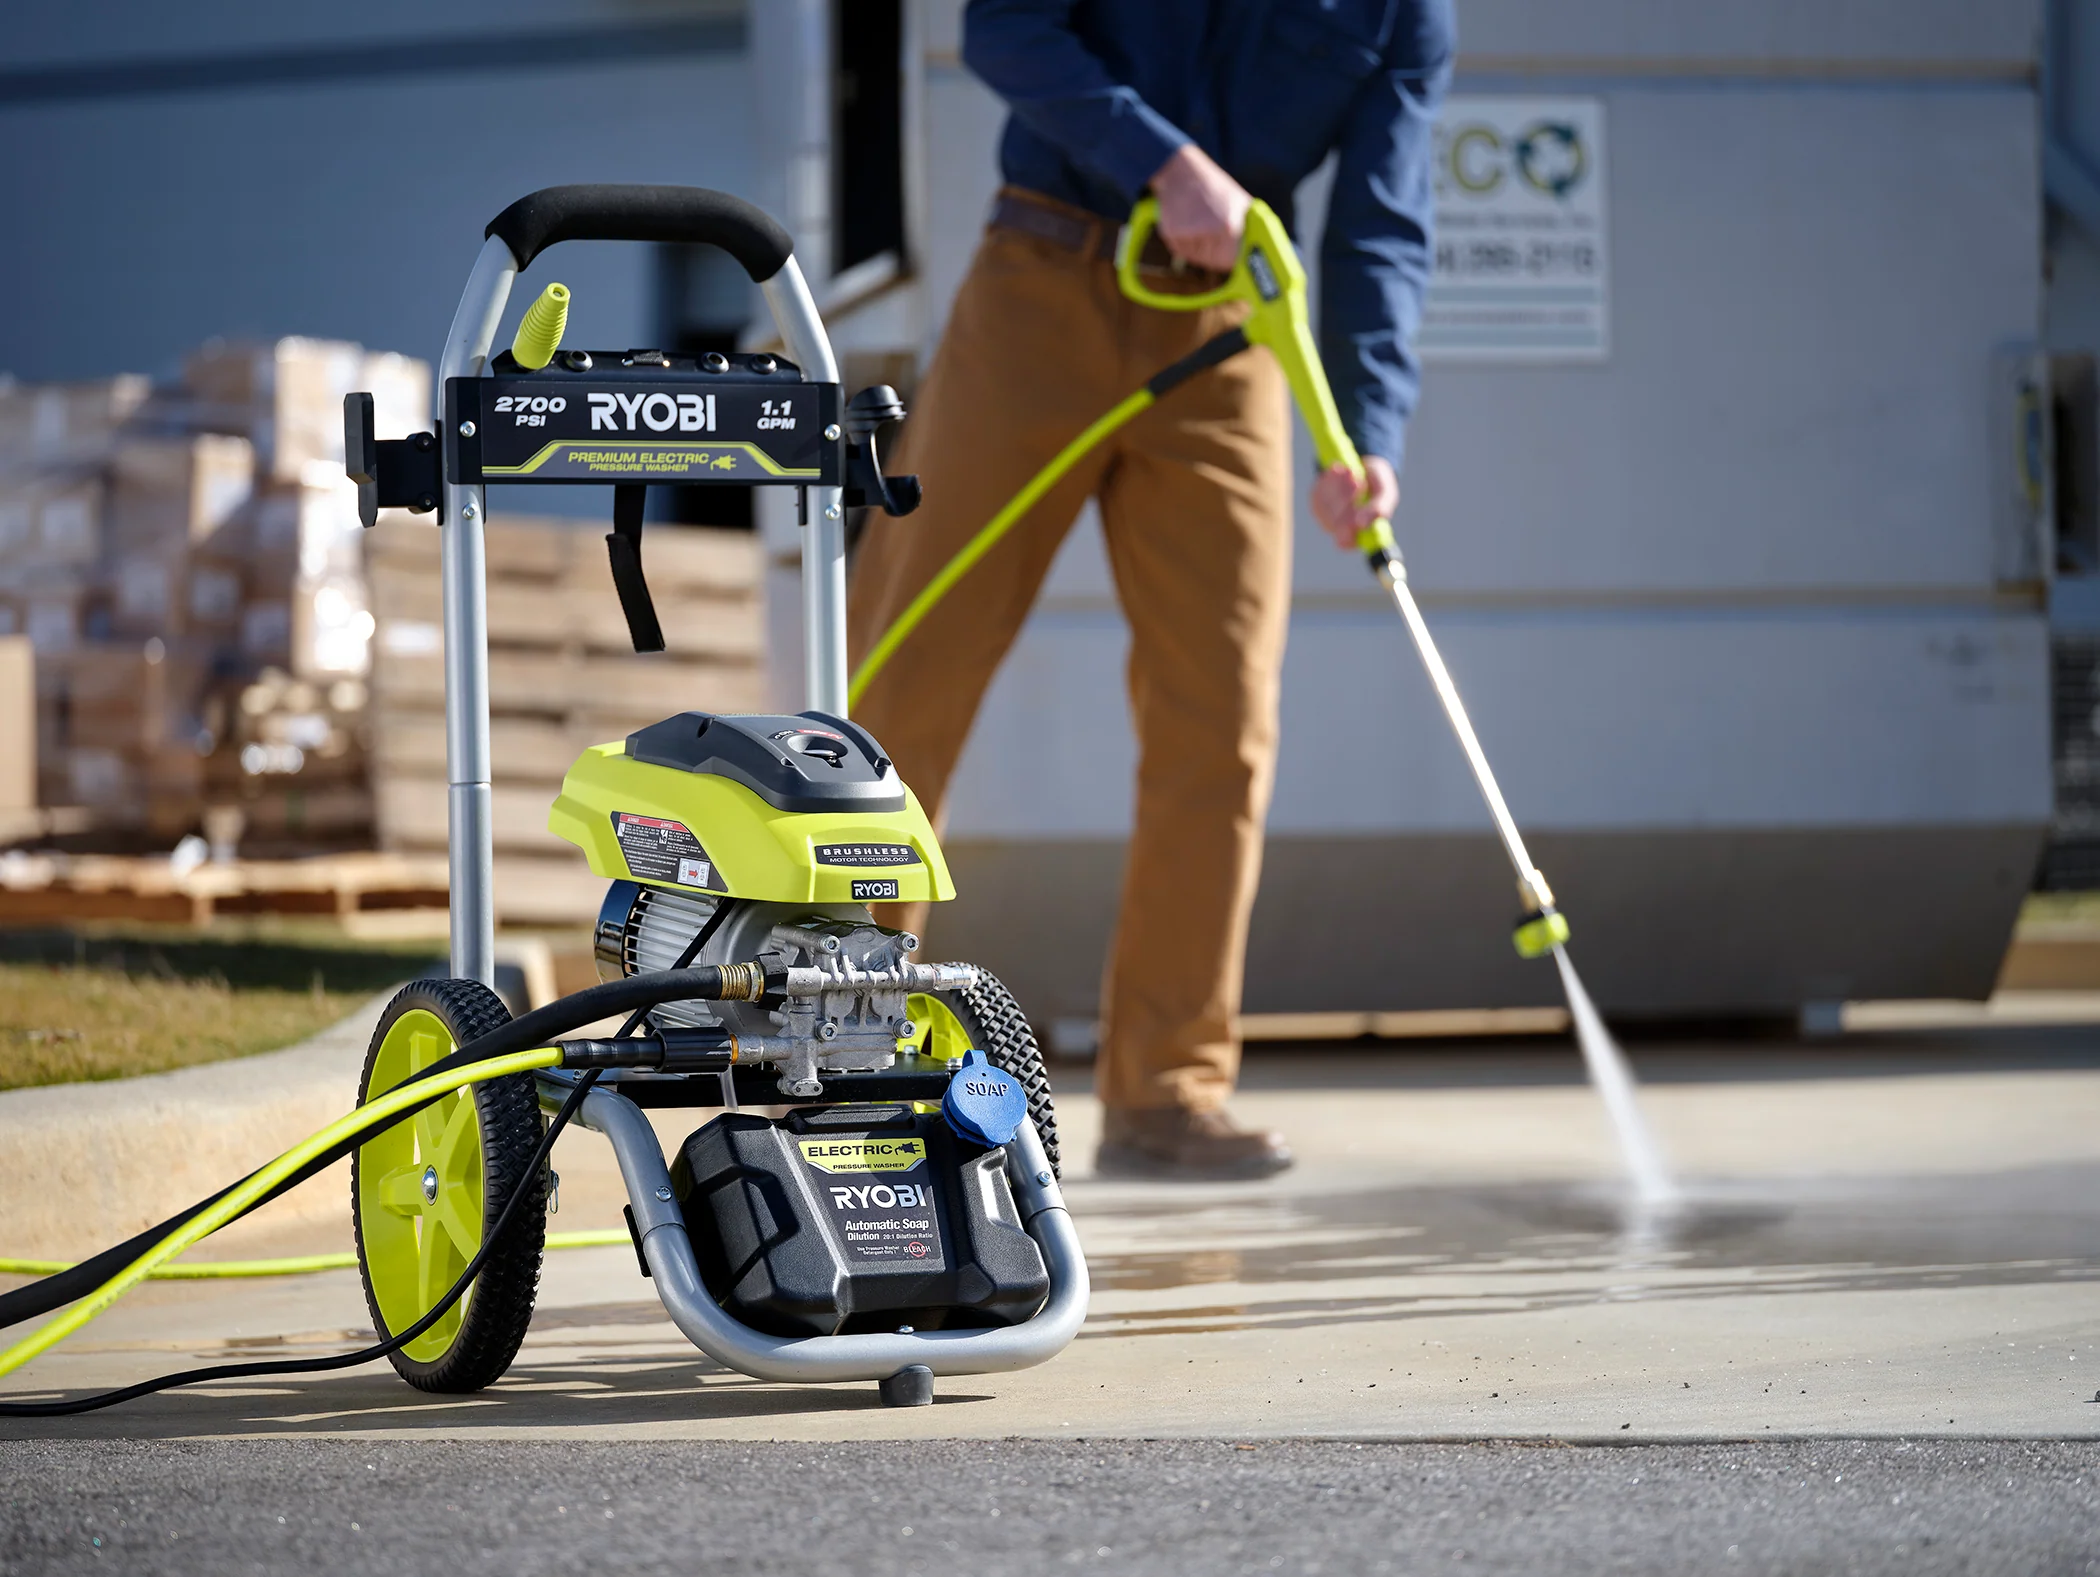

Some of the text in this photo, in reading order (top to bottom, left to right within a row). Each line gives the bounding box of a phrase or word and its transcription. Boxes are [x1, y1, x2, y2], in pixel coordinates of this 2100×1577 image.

[494, 396, 567, 413] 2700
[761, 400, 792, 416] 1.1
[587, 392, 716, 432] RYOBI
[515, 414, 547, 427] PSI
[756, 417, 796, 430] GPM
[568, 451, 709, 464] PREMIUM ELECTRIC
[589, 463, 689, 472] PRESSURE WASHER
[853, 883, 896, 896] RYOBI
[965, 1082, 1008, 1097] SOAP
[808, 1144, 893, 1157] ELECTRIC
[829, 1184, 926, 1209] RYOBI
[845, 1218, 929, 1231] Automatic Soap
[847, 1231, 880, 1240] Dilution
[903, 1245, 932, 1253] BLEACH
